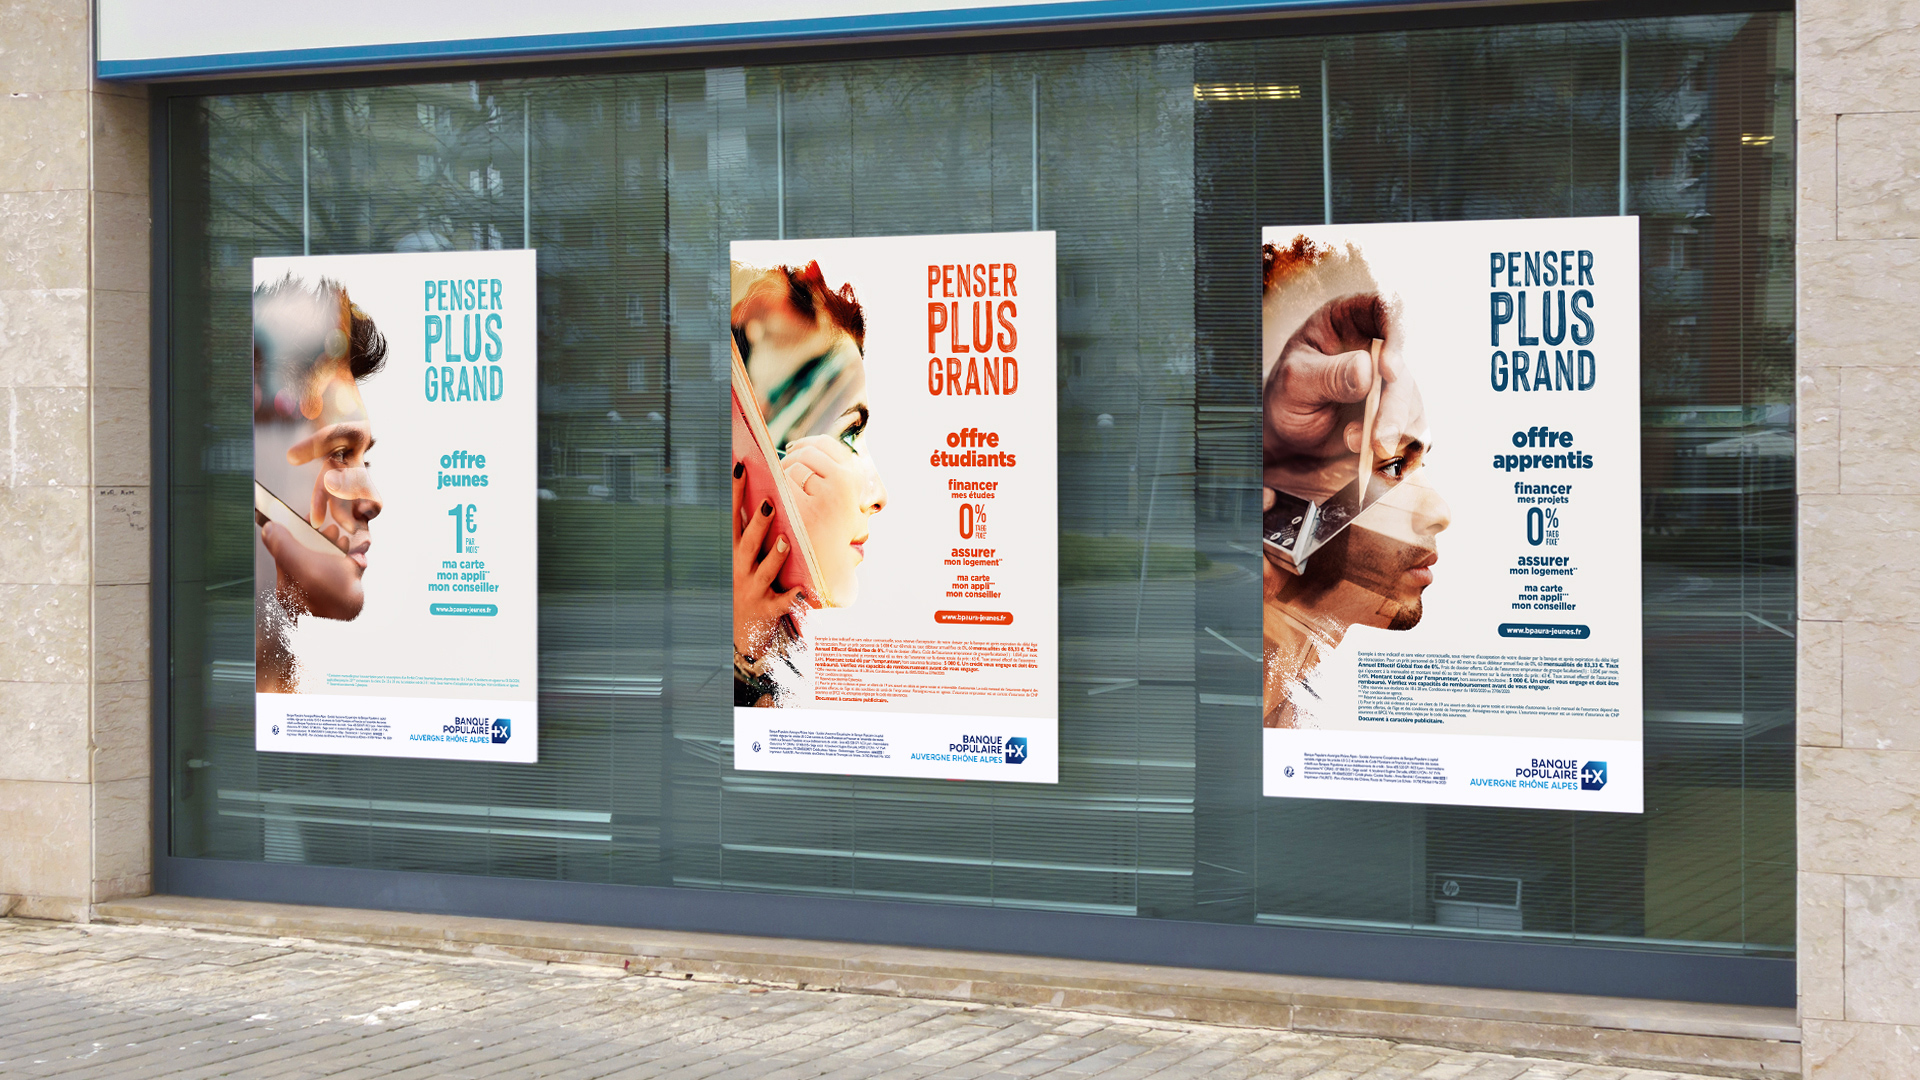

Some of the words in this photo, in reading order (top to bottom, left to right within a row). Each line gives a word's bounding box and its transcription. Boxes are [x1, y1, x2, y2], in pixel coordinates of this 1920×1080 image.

[1490, 250, 1594, 288] PENSER
[928, 263, 1017, 298] PENSER
[425, 279, 502, 311] PENSER
[1490, 289, 1595, 347] PLUS
[928, 300, 1017, 354] PLUS
[425, 313, 502, 363] PLUS
[928, 357, 1018, 396] GRAND
[1490, 349, 1596, 392] GRAND
[425, 365, 503, 402] GRAND
[946, 428, 1000, 448] offre
[1512, 426, 1574, 448] offre
[440, 450, 486, 469] offre
[930, 449, 1016, 467] étudiants
[1493, 450, 1594, 472] apprentis
[437, 471, 489, 490] jeunes
[948, 479, 998, 491] financer
[1514, 482, 1572, 494] financer
[969, 491, 995, 499] études
[1517, 496, 1535, 504] mes
[1538, 496, 1569, 505] projets
[959, 503, 987, 540] 0%
[1527, 507, 1559, 546] 0%
[448, 504, 477, 553] 1€
[1546, 530, 1560, 538] TAEG
[951, 548, 996, 558] assurer
[442, 561, 457, 569] ma
[460, 560, 485, 569] carte
[1517, 556, 1569, 567] assurer
[437, 571, 458, 580] mon
[1510, 567, 1529, 575] mon
[970, 574, 990, 582] carte
[428, 583, 450, 592] mon
[452, 582, 499, 592] conseiller
[964, 590, 1001, 599] conseiller
[1512, 602, 1532, 610] mon
[1533, 602, 1576, 611] conseiller
[1506, 627, 1582, 636] www.bpaura-jeunes.fr
[455, 717, 489, 726] BANQUE
[443, 725, 489, 734] POPULAIRE
[409, 734, 444, 742] AUVERGNE
[446, 734, 468, 743] RHÔNE
[469, 736, 490, 744] ALPES
[962, 734, 1002, 744] BANQUE
[949, 743, 1002, 754] POPULAIRE
[910, 753, 951, 762] AUVERGNE
[952, 753, 978, 763] RHÔNE
[979, 756, 1003, 764] ALPES
[1531, 758, 1578, 770] BANQUE
[1516, 768, 1578, 780] POPULAIRE
[1470, 778, 1517, 788] AUVERGNE
[1519, 779, 1549, 789] RHÔNE
[1551, 781, 1578, 791] ALPES
